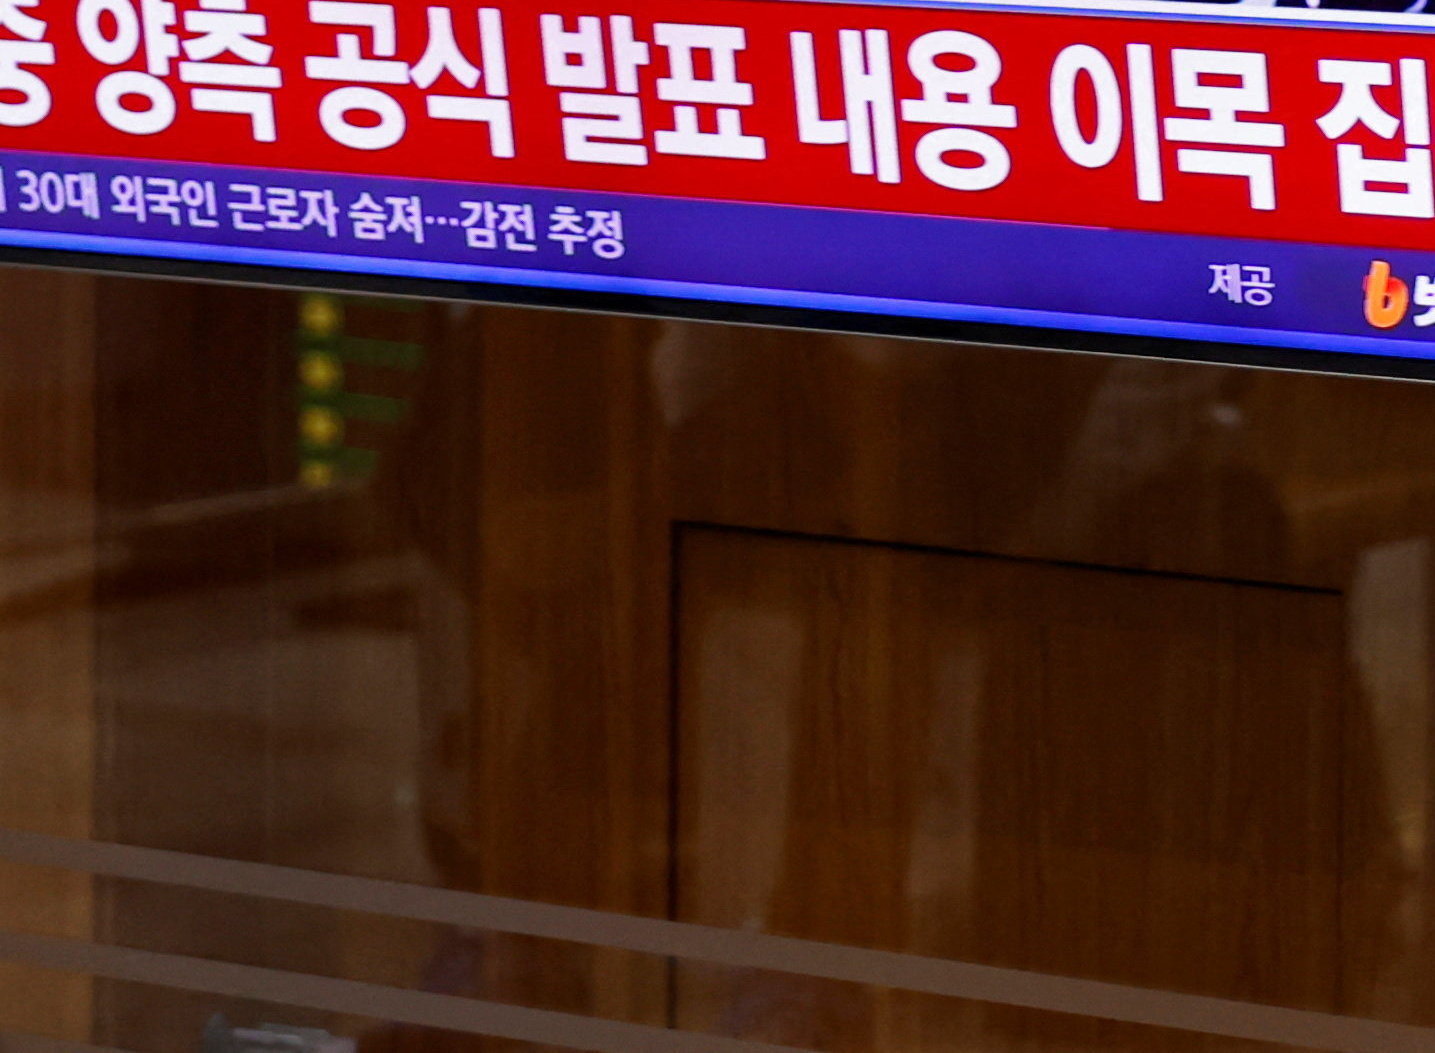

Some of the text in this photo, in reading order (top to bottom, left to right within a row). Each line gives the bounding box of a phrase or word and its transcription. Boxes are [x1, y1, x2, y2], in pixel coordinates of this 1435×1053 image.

[304, 0, 515, 159] 공식
[540, 14, 766, 166] 발표
[789, 29, 1017, 192] 내용
[1050, 43, 1285, 211] 이목
[16, 169, 100, 219] 30대
[110, 175, 219, 228] 외국인
[227, 183, 340, 238] 근로자
[547, 205, 625, 259] 추정
[1208, 263, 1276, 306] 제공
